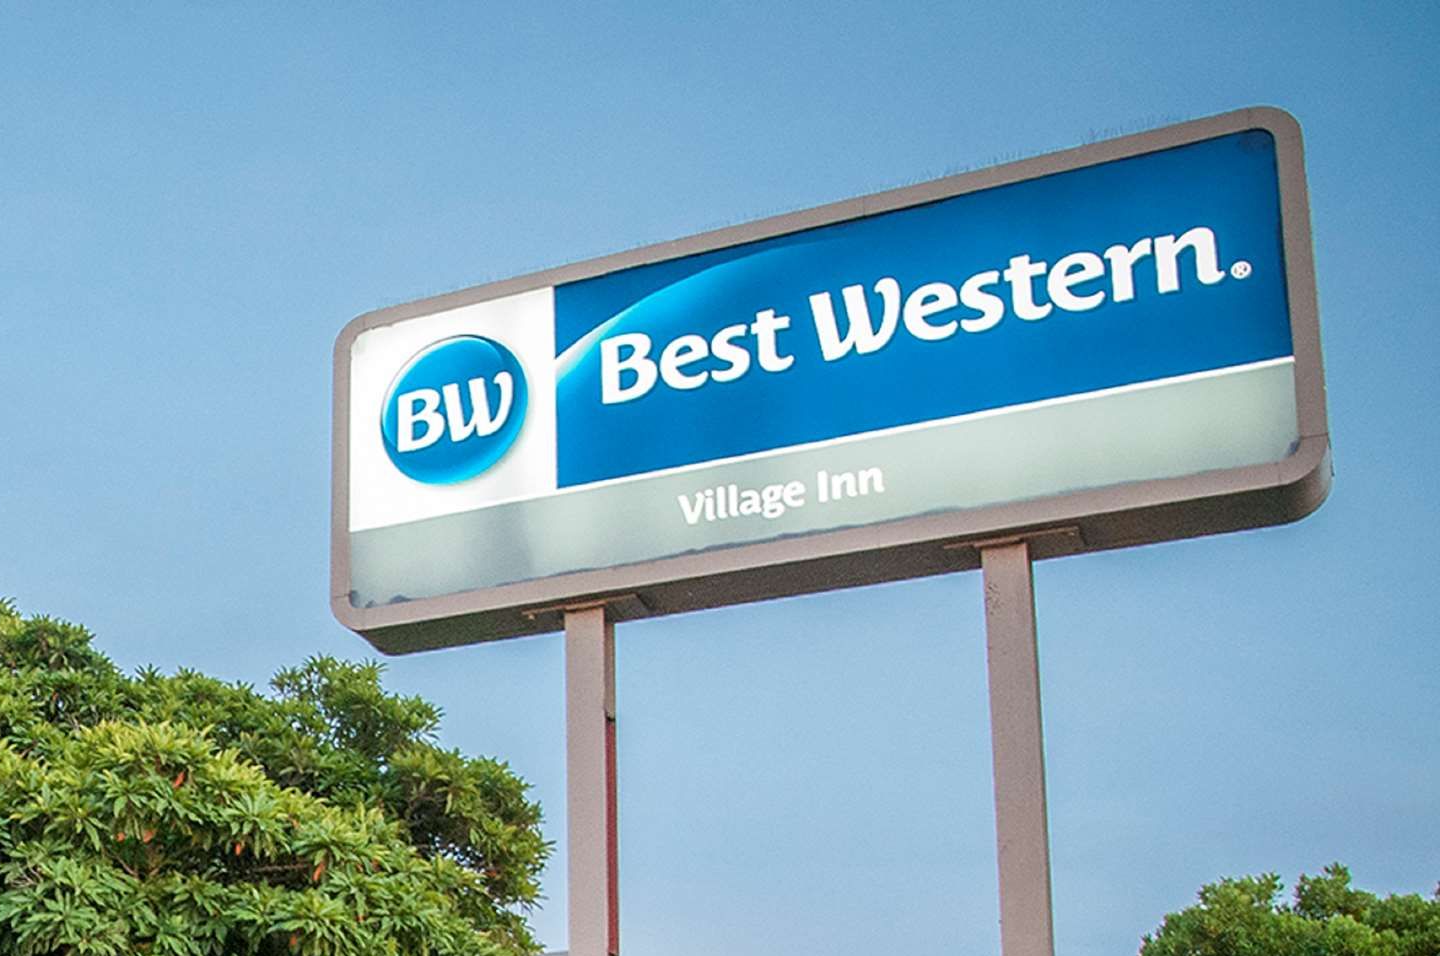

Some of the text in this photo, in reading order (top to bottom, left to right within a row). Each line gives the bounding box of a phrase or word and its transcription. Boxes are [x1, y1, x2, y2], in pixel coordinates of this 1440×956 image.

[600, 227, 1227, 405] Best Western
[397, 371, 514, 453] BW
[678, 467, 885, 525] Village Inn
